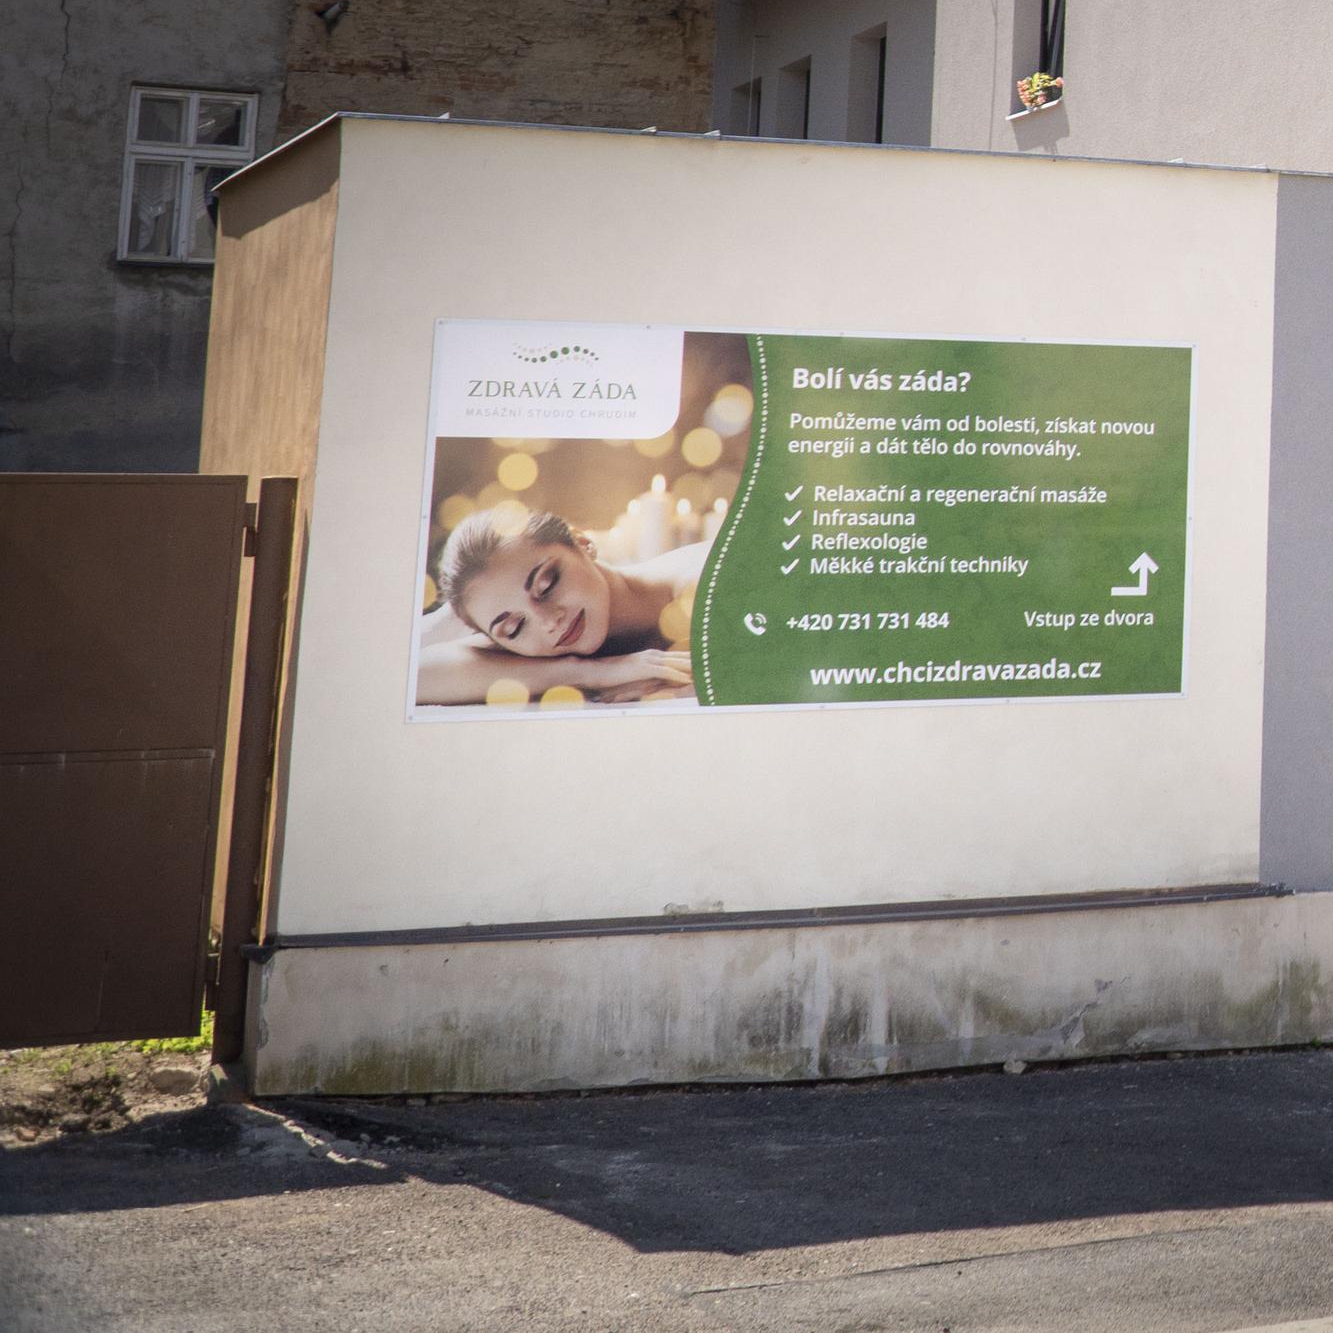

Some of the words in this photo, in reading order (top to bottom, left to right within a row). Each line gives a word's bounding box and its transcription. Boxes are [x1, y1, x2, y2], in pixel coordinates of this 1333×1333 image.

[467, 378, 562, 399] ZDRAVÁ
[571, 379, 638, 400] ZÁDA
[793, 367, 844, 390] Bolí
[848, 368, 893, 391] vás
[898, 369, 972, 393] záda?
[465, 406, 522, 417] MASÁŽNÍ
[527, 409, 574, 418] STUDIO
[580, 410, 637, 419] CHRUDIM
[789, 411, 897, 430] Pomůžeme
[901, 414, 941, 431] vám
[946, 415, 970, 431] od
[975, 415, 1041, 435] bolesti,
[1044, 417, 1097, 434] získat
[1101, 421, 1155, 435] novou
[788, 437, 855, 458] energii
[859, 440, 871, 454] a
[876, 437, 909, 454] dát
[912, 438, 948, 455] tělo
[953, 438, 977, 455] do
[982, 440, 1081, 461] rovnováhy.
[814, 485, 907, 502] Relaxační
[909, 488, 921, 502] a
[926, 486, 1037, 507] regenerační
[1041, 486, 1107, 503] masáže
[812, 509, 916, 526] Infrasauna
[811, 533, 928, 554] Reflexologie
[810, 556, 874, 574] Měkké
[879, 556, 947, 573] trakční
[950, 556, 1029, 577] techniky
[786, 614, 833, 631] +420
[838, 613, 871, 630] 731
[877, 612, 909, 629] 731
[915, 612, 950, 629] 484
[1023, 610, 1076, 632] Vstup
[1079, 613, 1099, 627] ze
[1104, 609, 1155, 626] dvora
[810, 657, 1102, 685] www.chcizdravazada.cz
